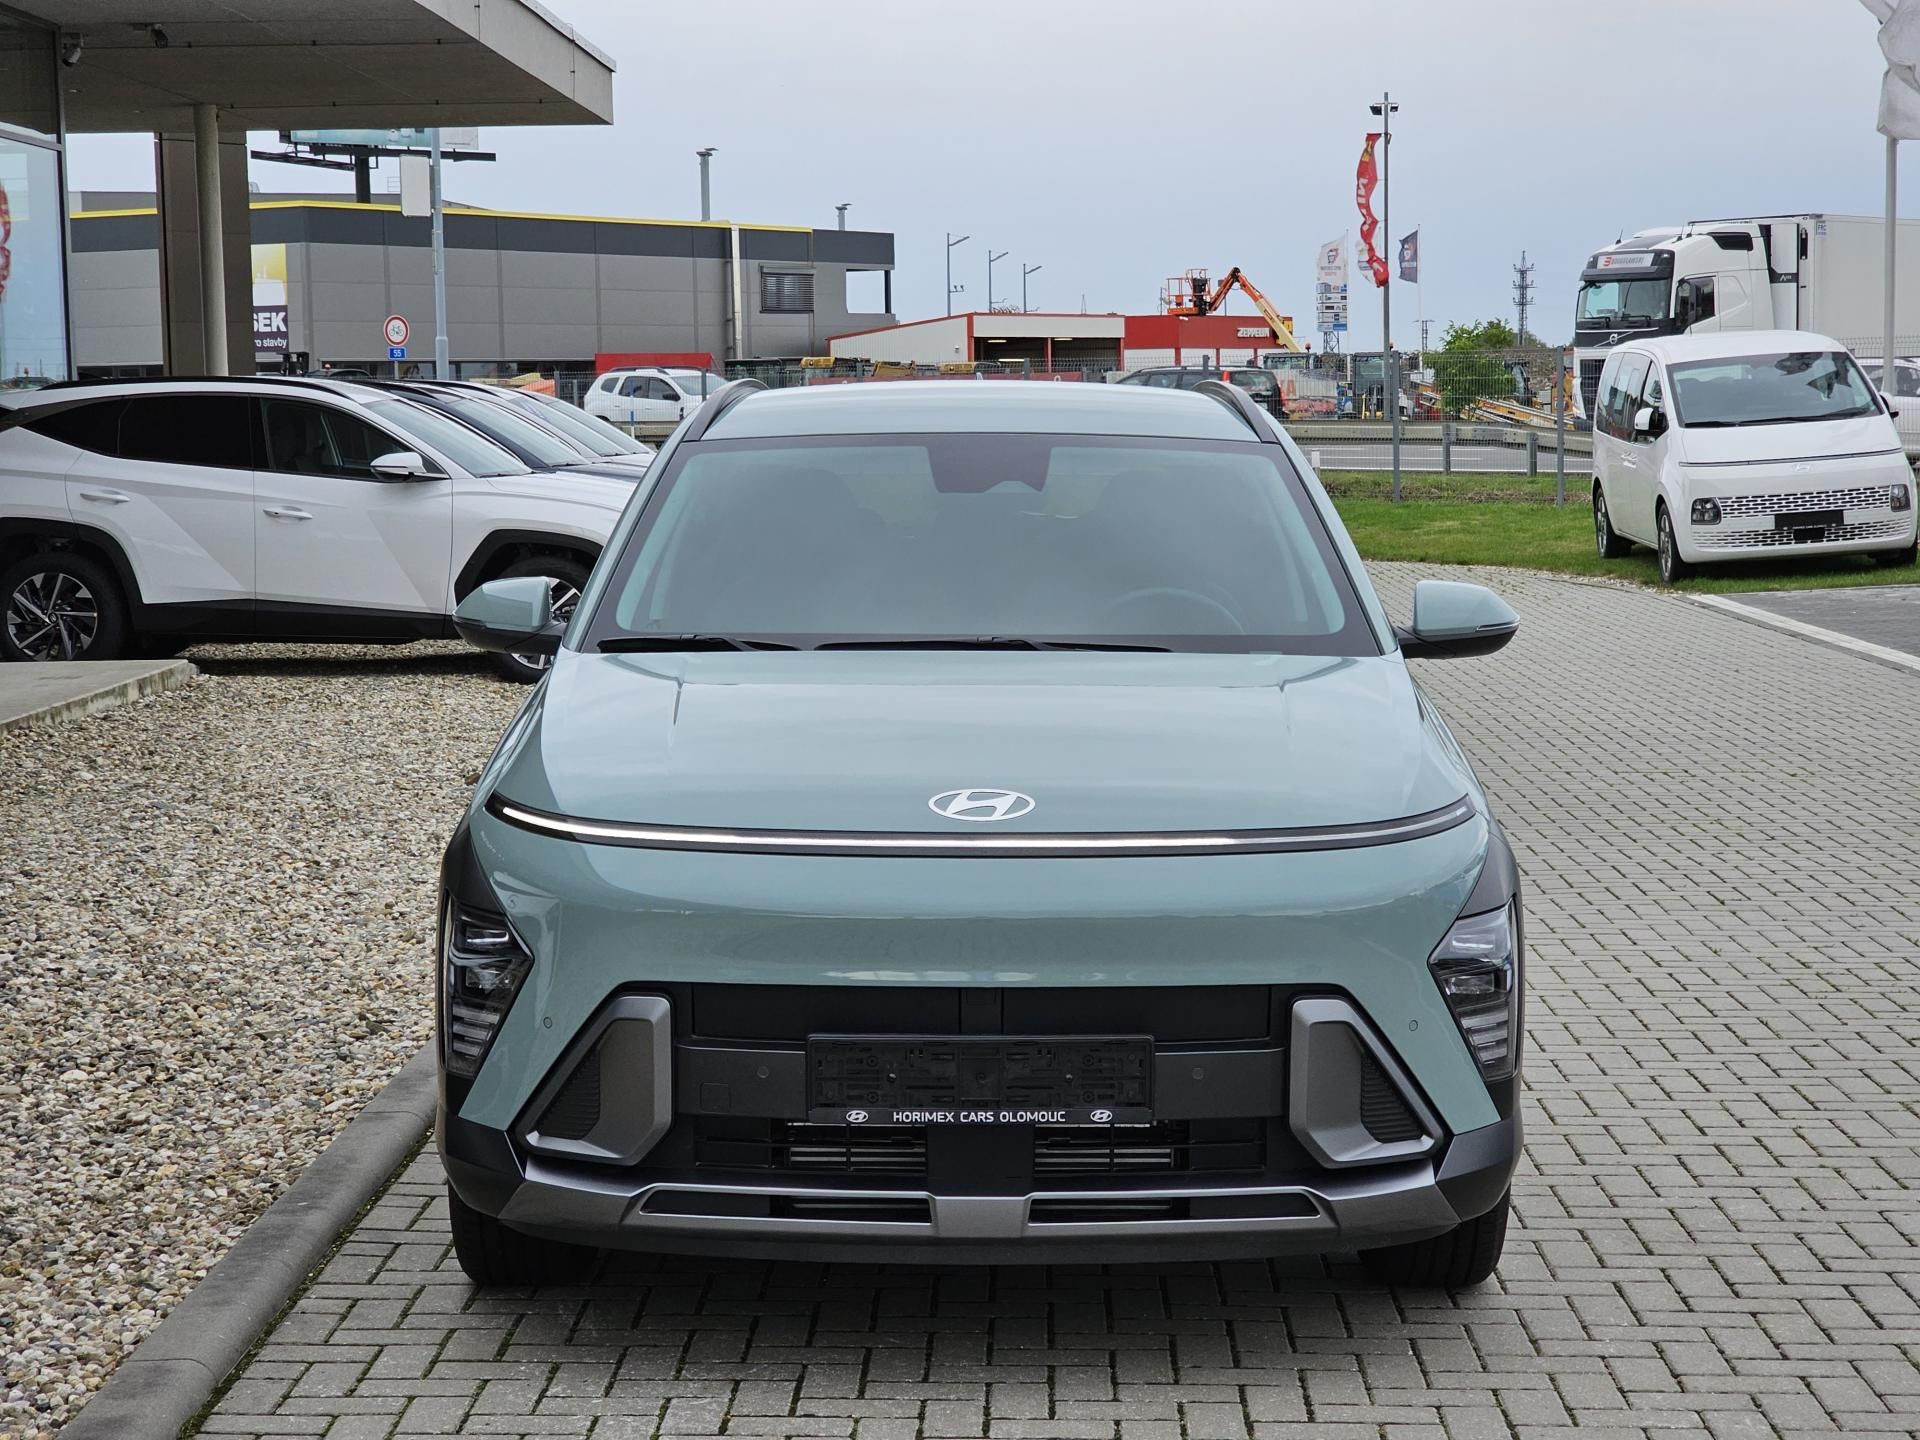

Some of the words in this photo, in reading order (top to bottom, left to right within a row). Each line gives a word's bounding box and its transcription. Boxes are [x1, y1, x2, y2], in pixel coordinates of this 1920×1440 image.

[263, 337, 287, 349] stavby
[893, 1111, 955, 1123] HORIMEX
[960, 1111, 994, 1123] CARS
[999, 1111, 1066, 1122] OLOMOUC
